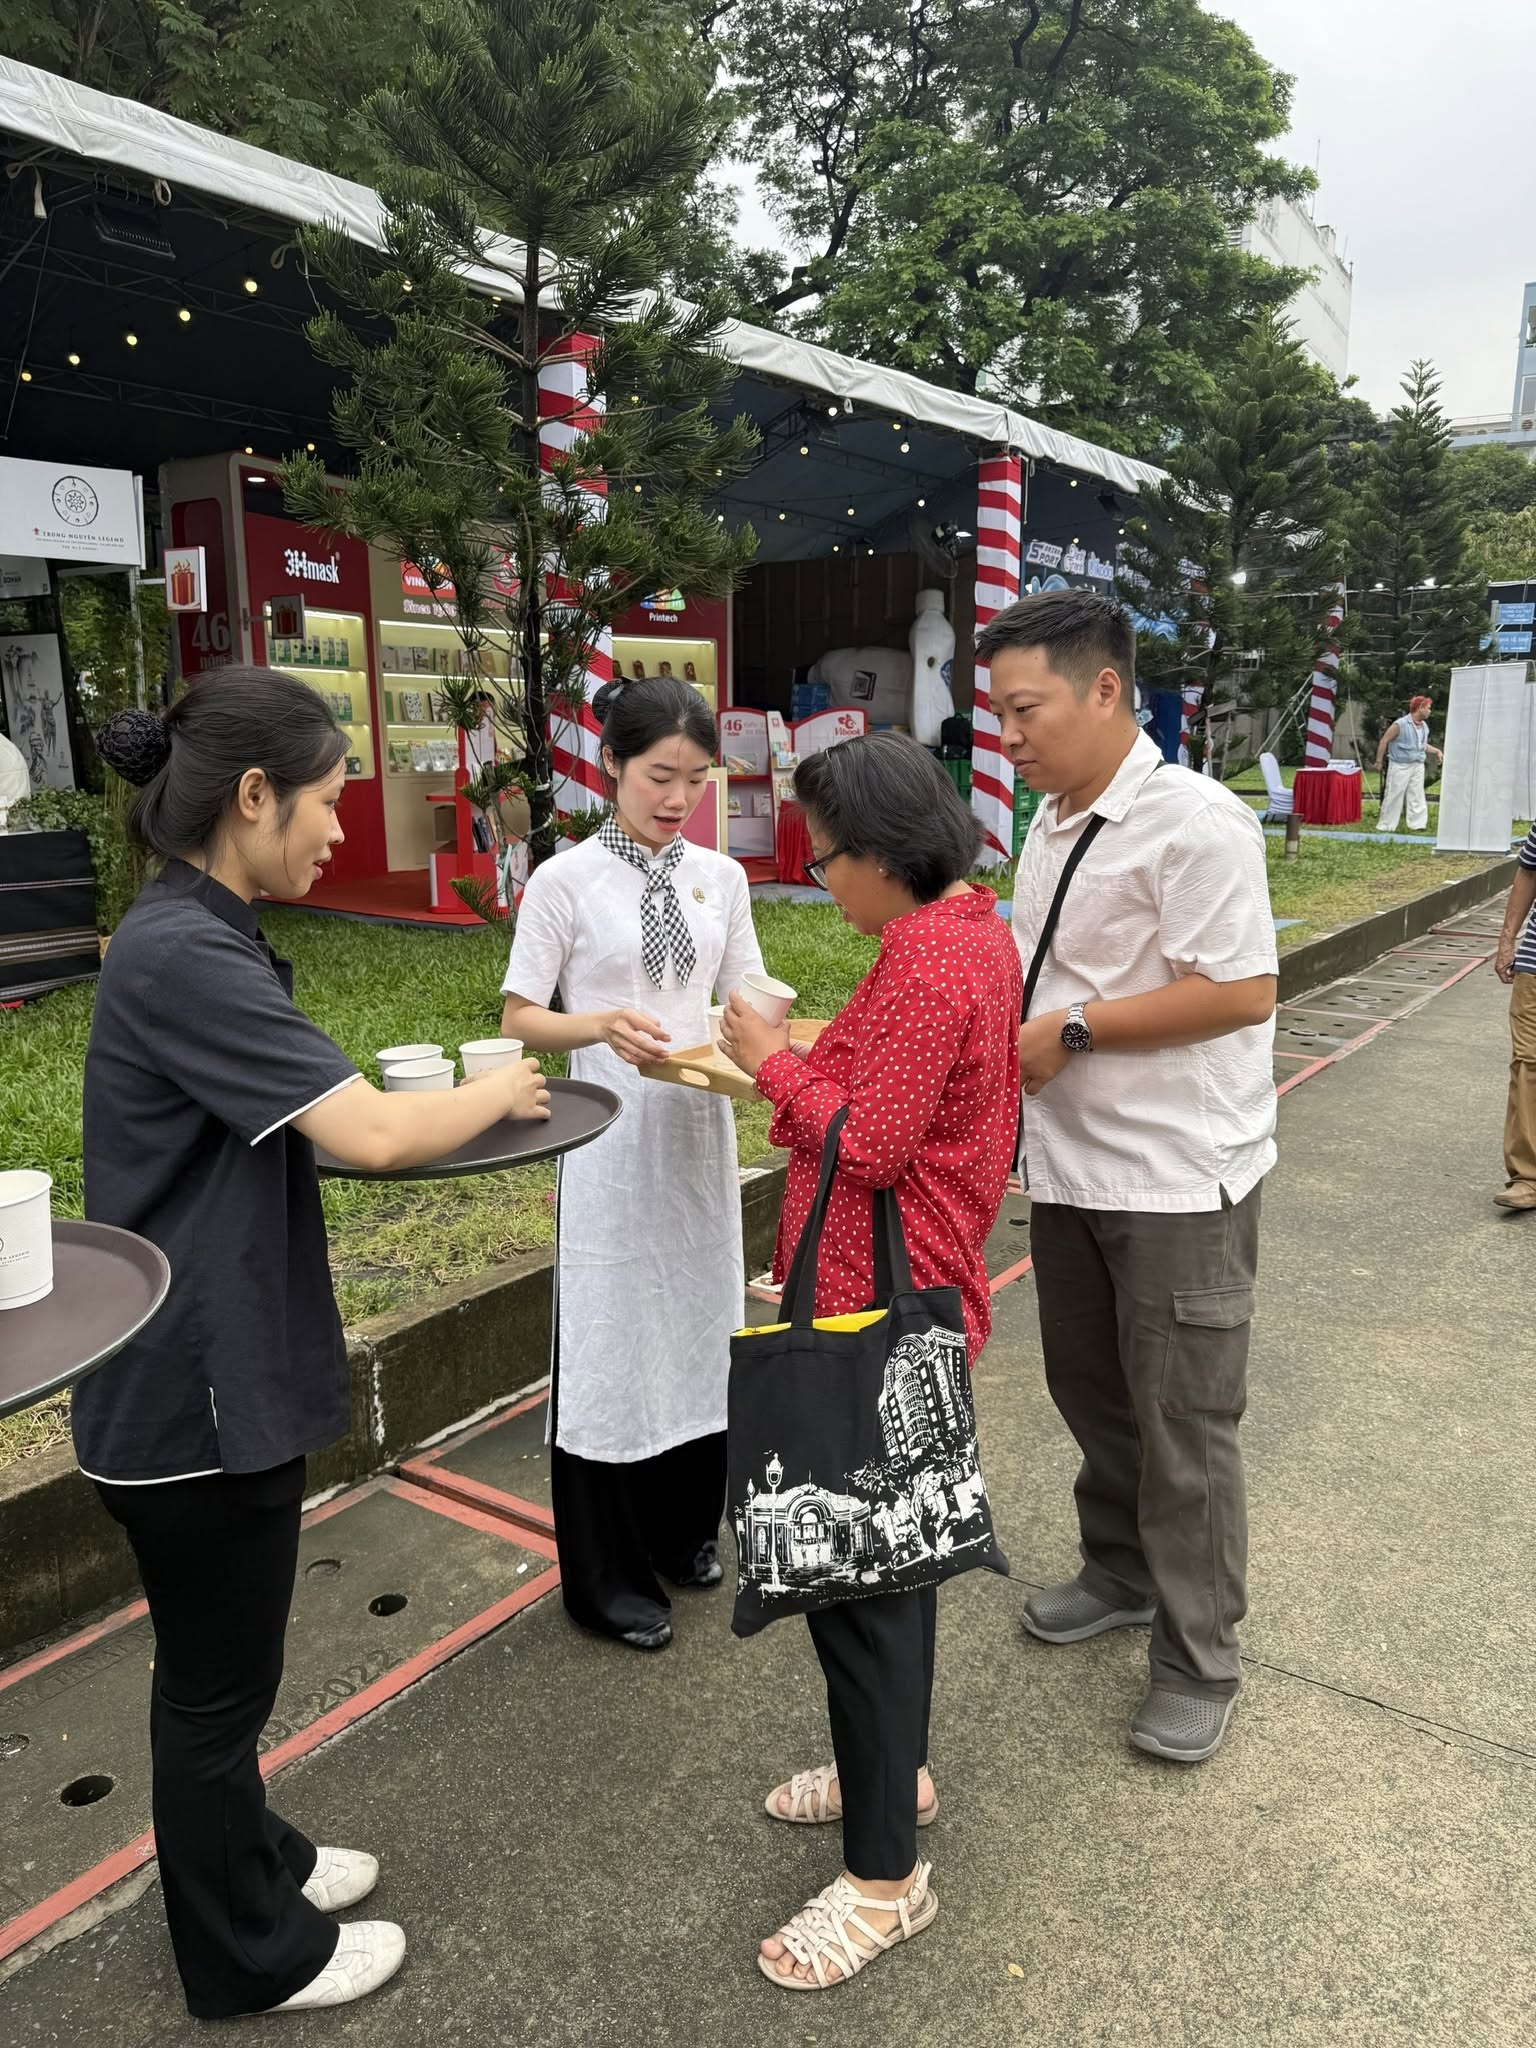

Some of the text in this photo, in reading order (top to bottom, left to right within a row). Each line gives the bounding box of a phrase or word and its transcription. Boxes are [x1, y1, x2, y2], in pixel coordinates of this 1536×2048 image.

[649, 612, 678, 623] Printech
[192, 612, 231, 651] 46
[724, 719, 743, 731] 46
